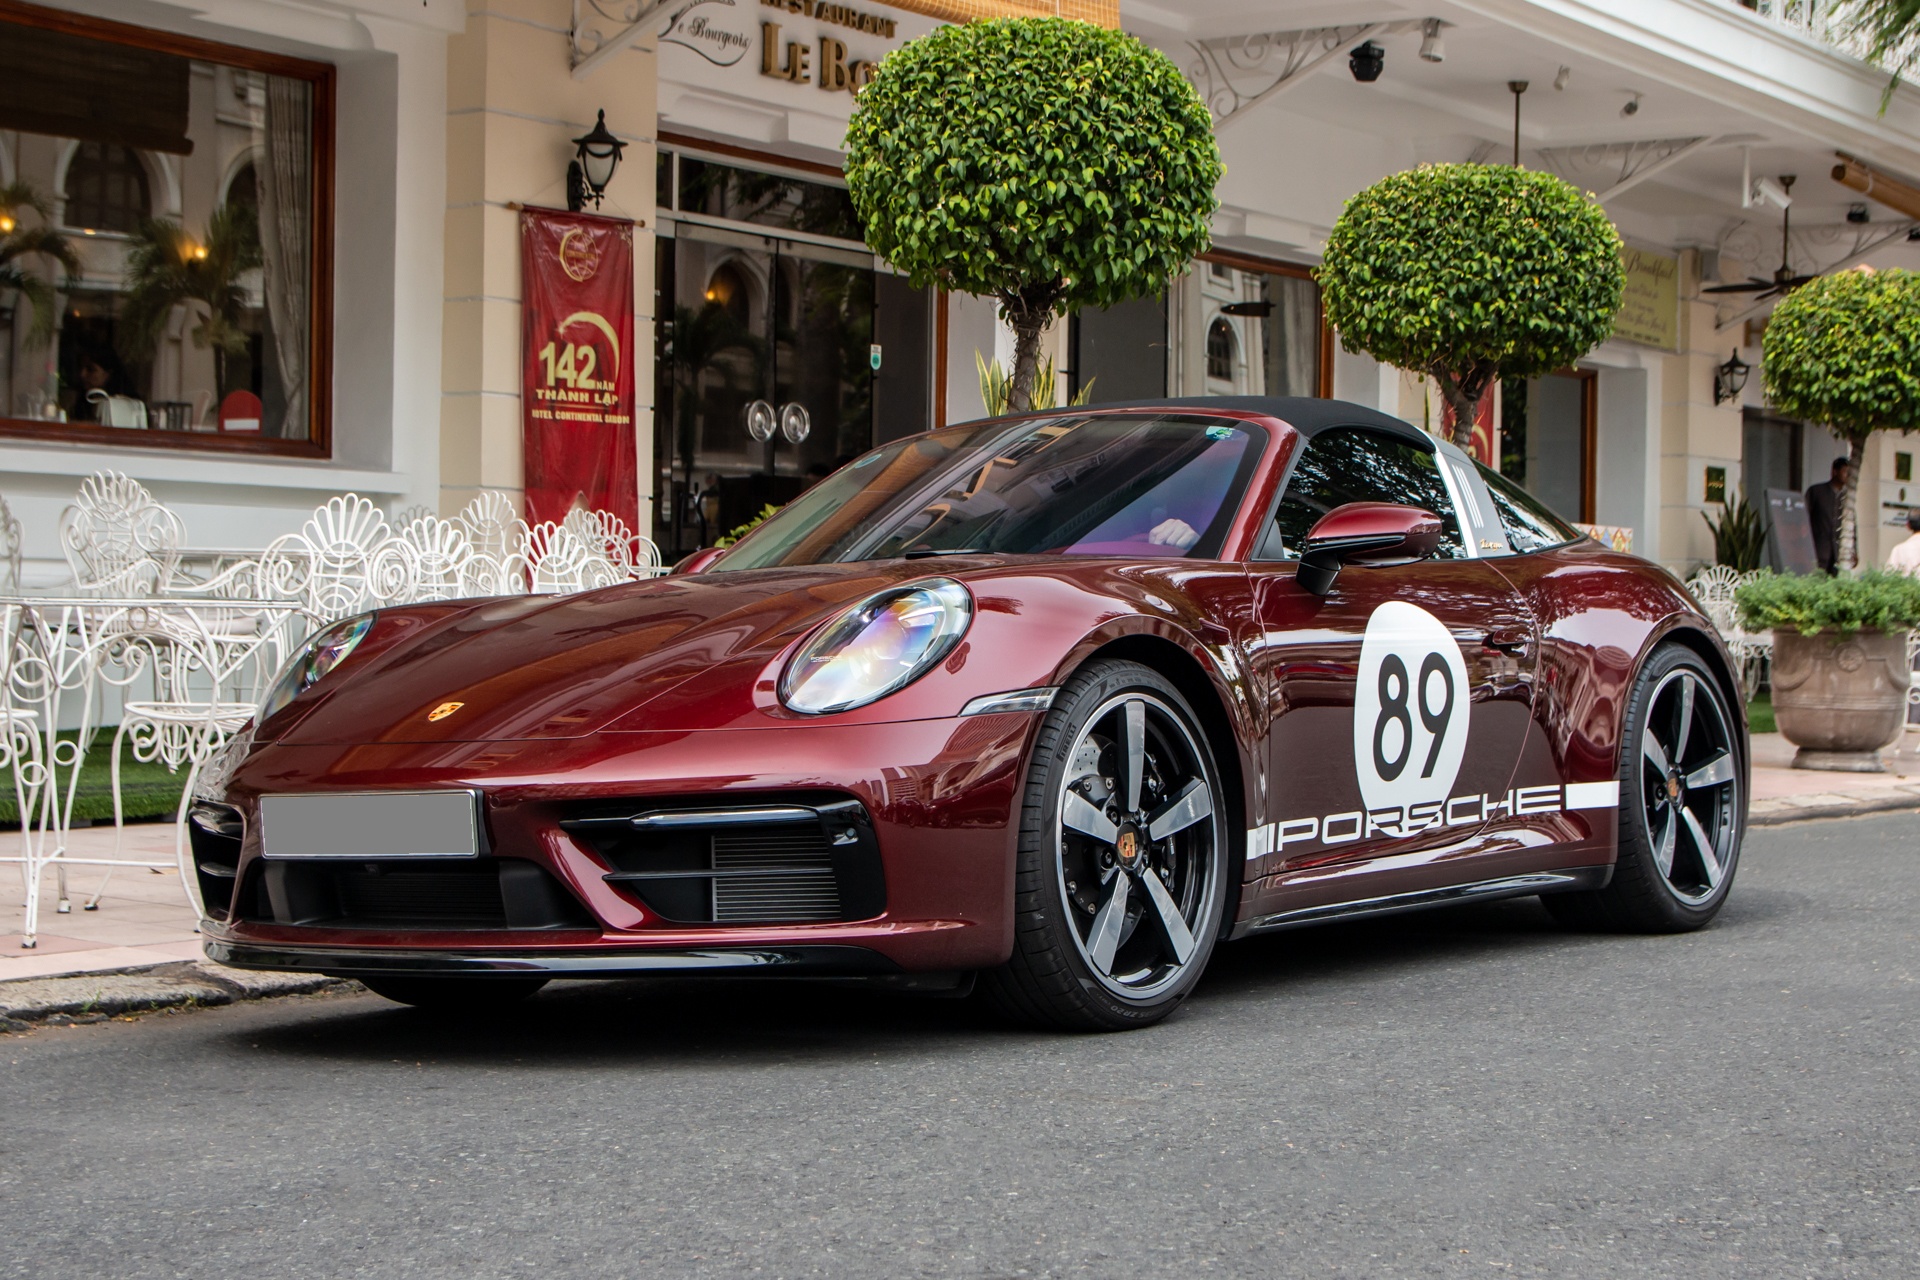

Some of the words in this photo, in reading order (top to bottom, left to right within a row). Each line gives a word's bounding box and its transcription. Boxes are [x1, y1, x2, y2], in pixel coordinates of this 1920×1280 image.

[688, 16, 749, 50] Bourgeois
[760, 0, 897, 38] STAURANT
[760, 22, 811, 84] LE
[539, 341, 597, 390] 142
[1373, 651, 1454, 782] 89
[1277, 784, 1561, 852] PORSCHE
